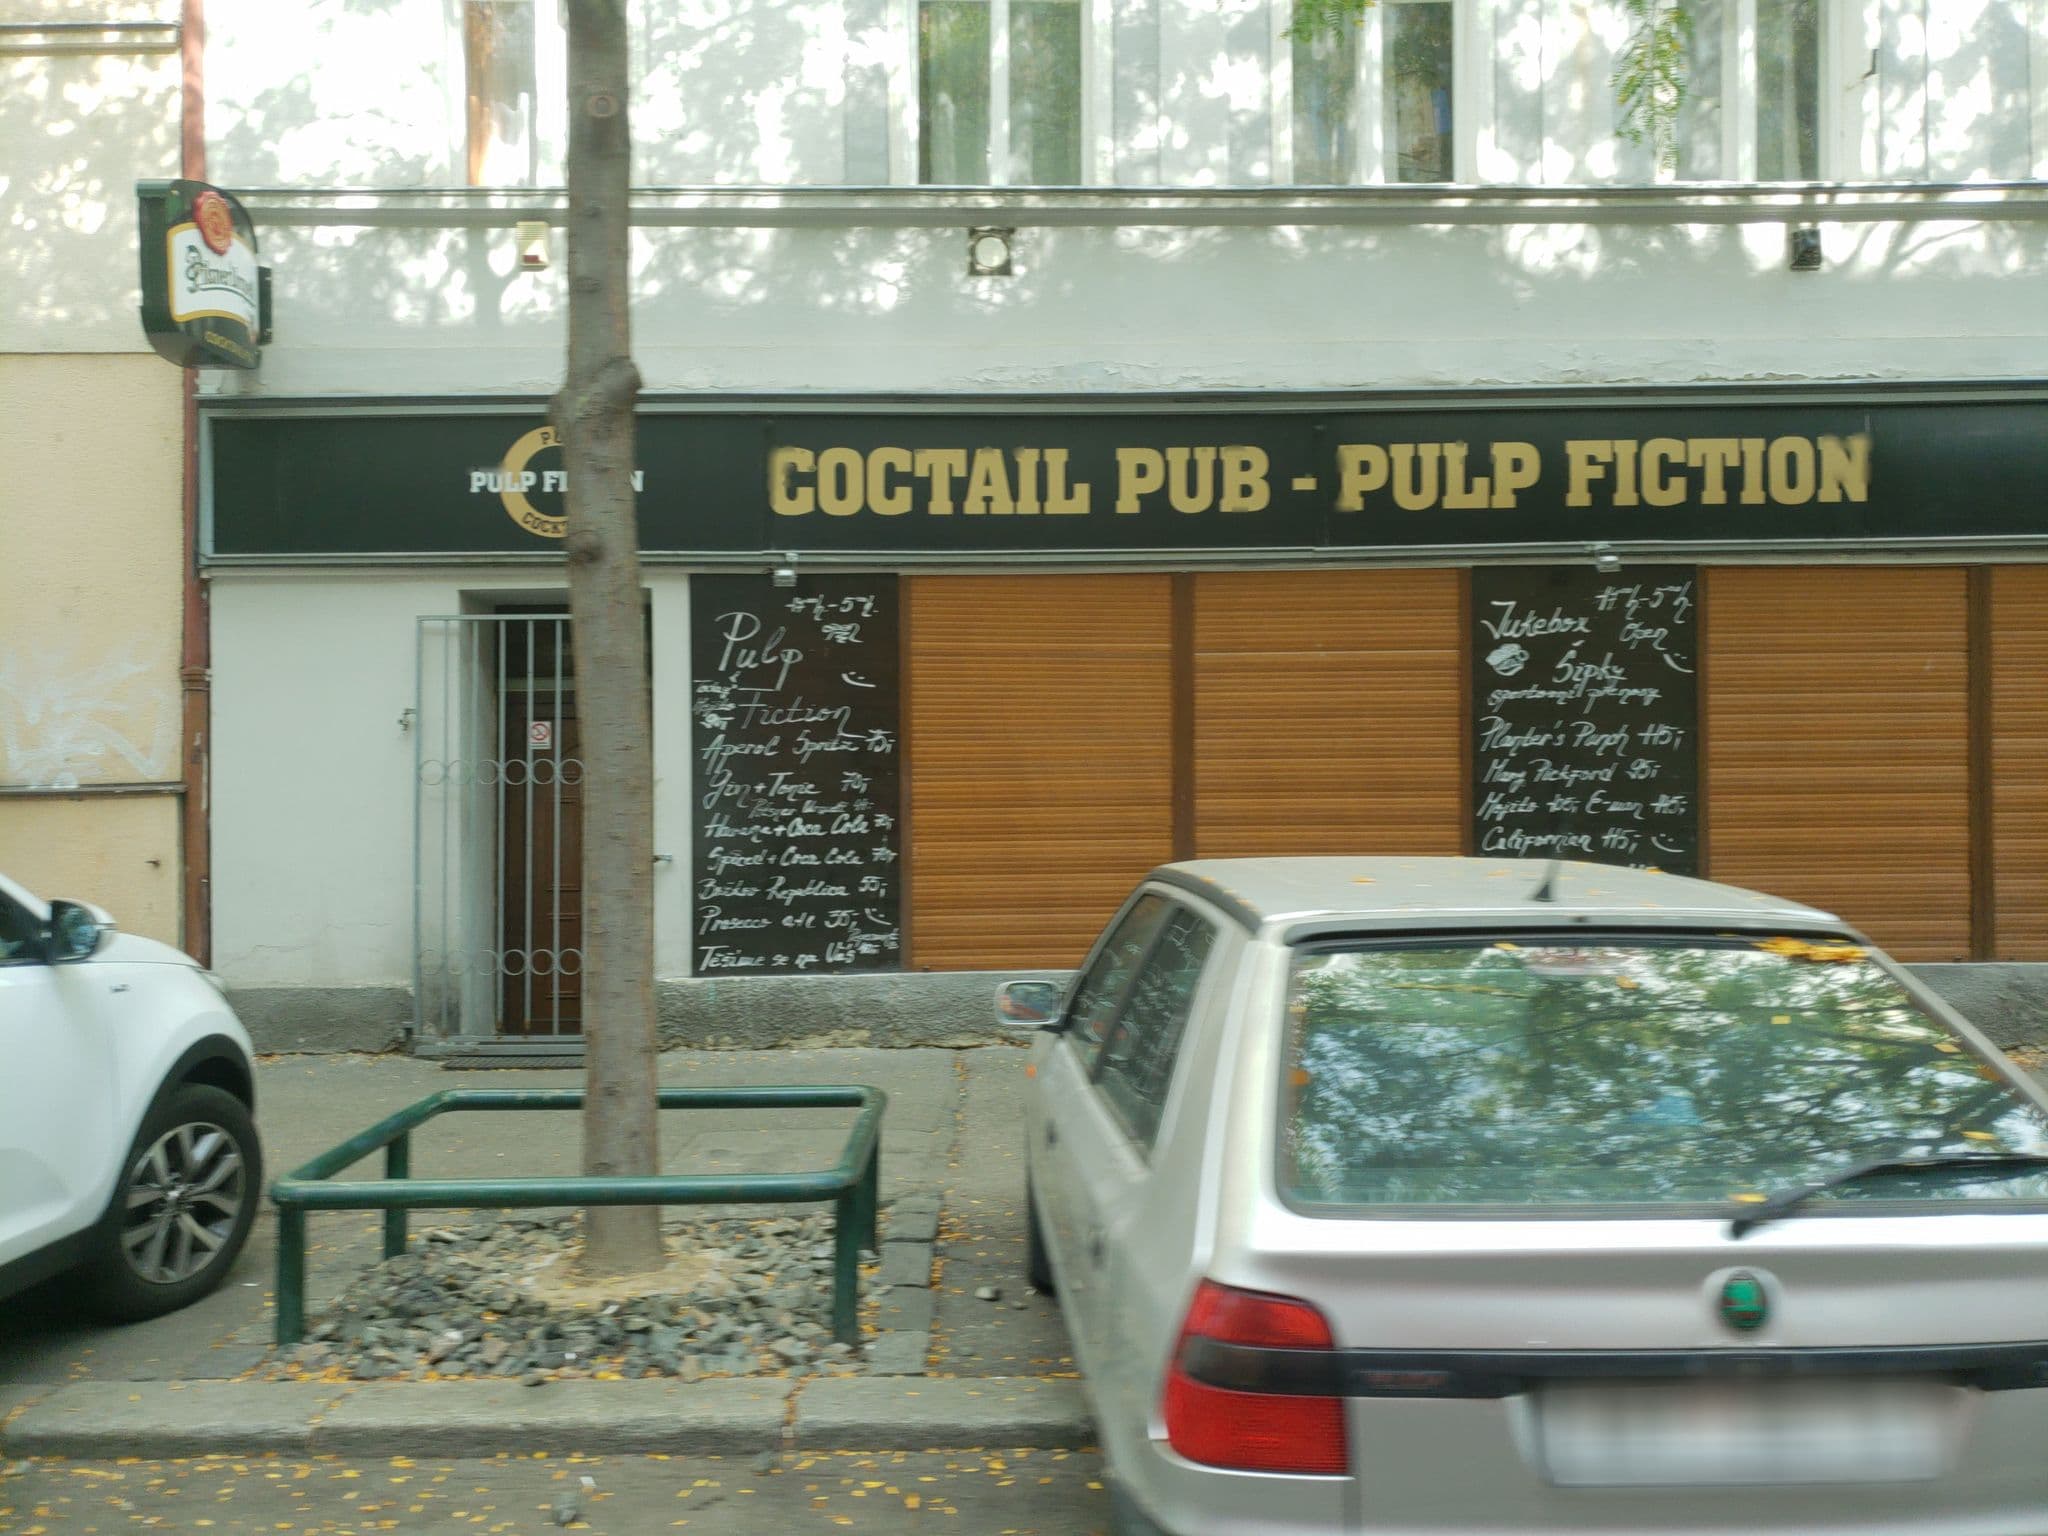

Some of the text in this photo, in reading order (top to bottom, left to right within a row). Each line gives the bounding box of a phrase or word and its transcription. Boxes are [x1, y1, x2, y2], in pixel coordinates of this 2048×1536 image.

[469, 470, 536, 493] PULP
[769, 435, 1870, 516] COCTAIL PUB - PULP FICTION
[1480, 601, 1592, 640] Jukebox
[714, 611, 803, 691] Pulp
[736, 690, 868, 738] Fiction
